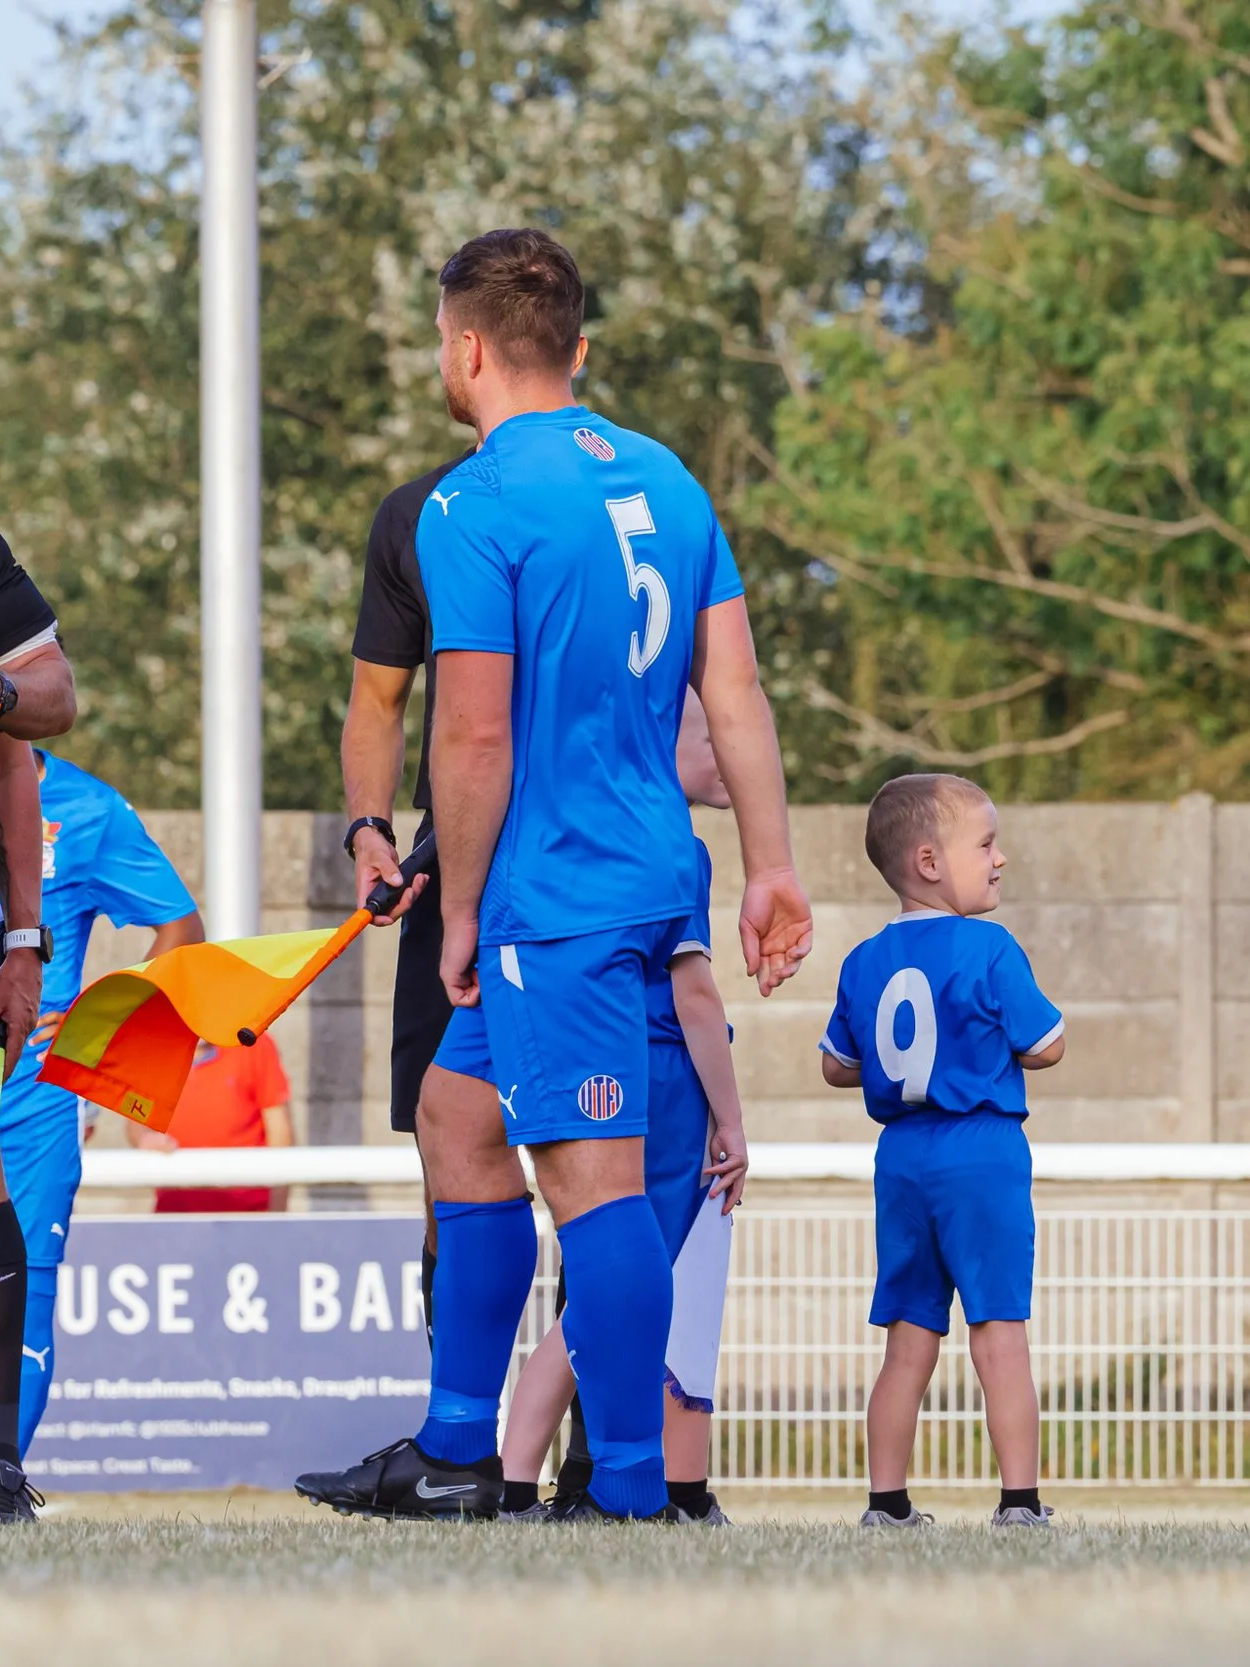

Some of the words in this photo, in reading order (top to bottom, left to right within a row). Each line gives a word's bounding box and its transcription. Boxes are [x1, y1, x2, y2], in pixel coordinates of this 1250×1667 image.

[605, 492, 671, 678] 5
[876, 967, 938, 1104] 9
[57, 1263, 195, 1335] USE
[222, 1262, 270, 1334] &
[63, 1378, 93, 1400] for
[302, 1376, 377, 1401] Draught
